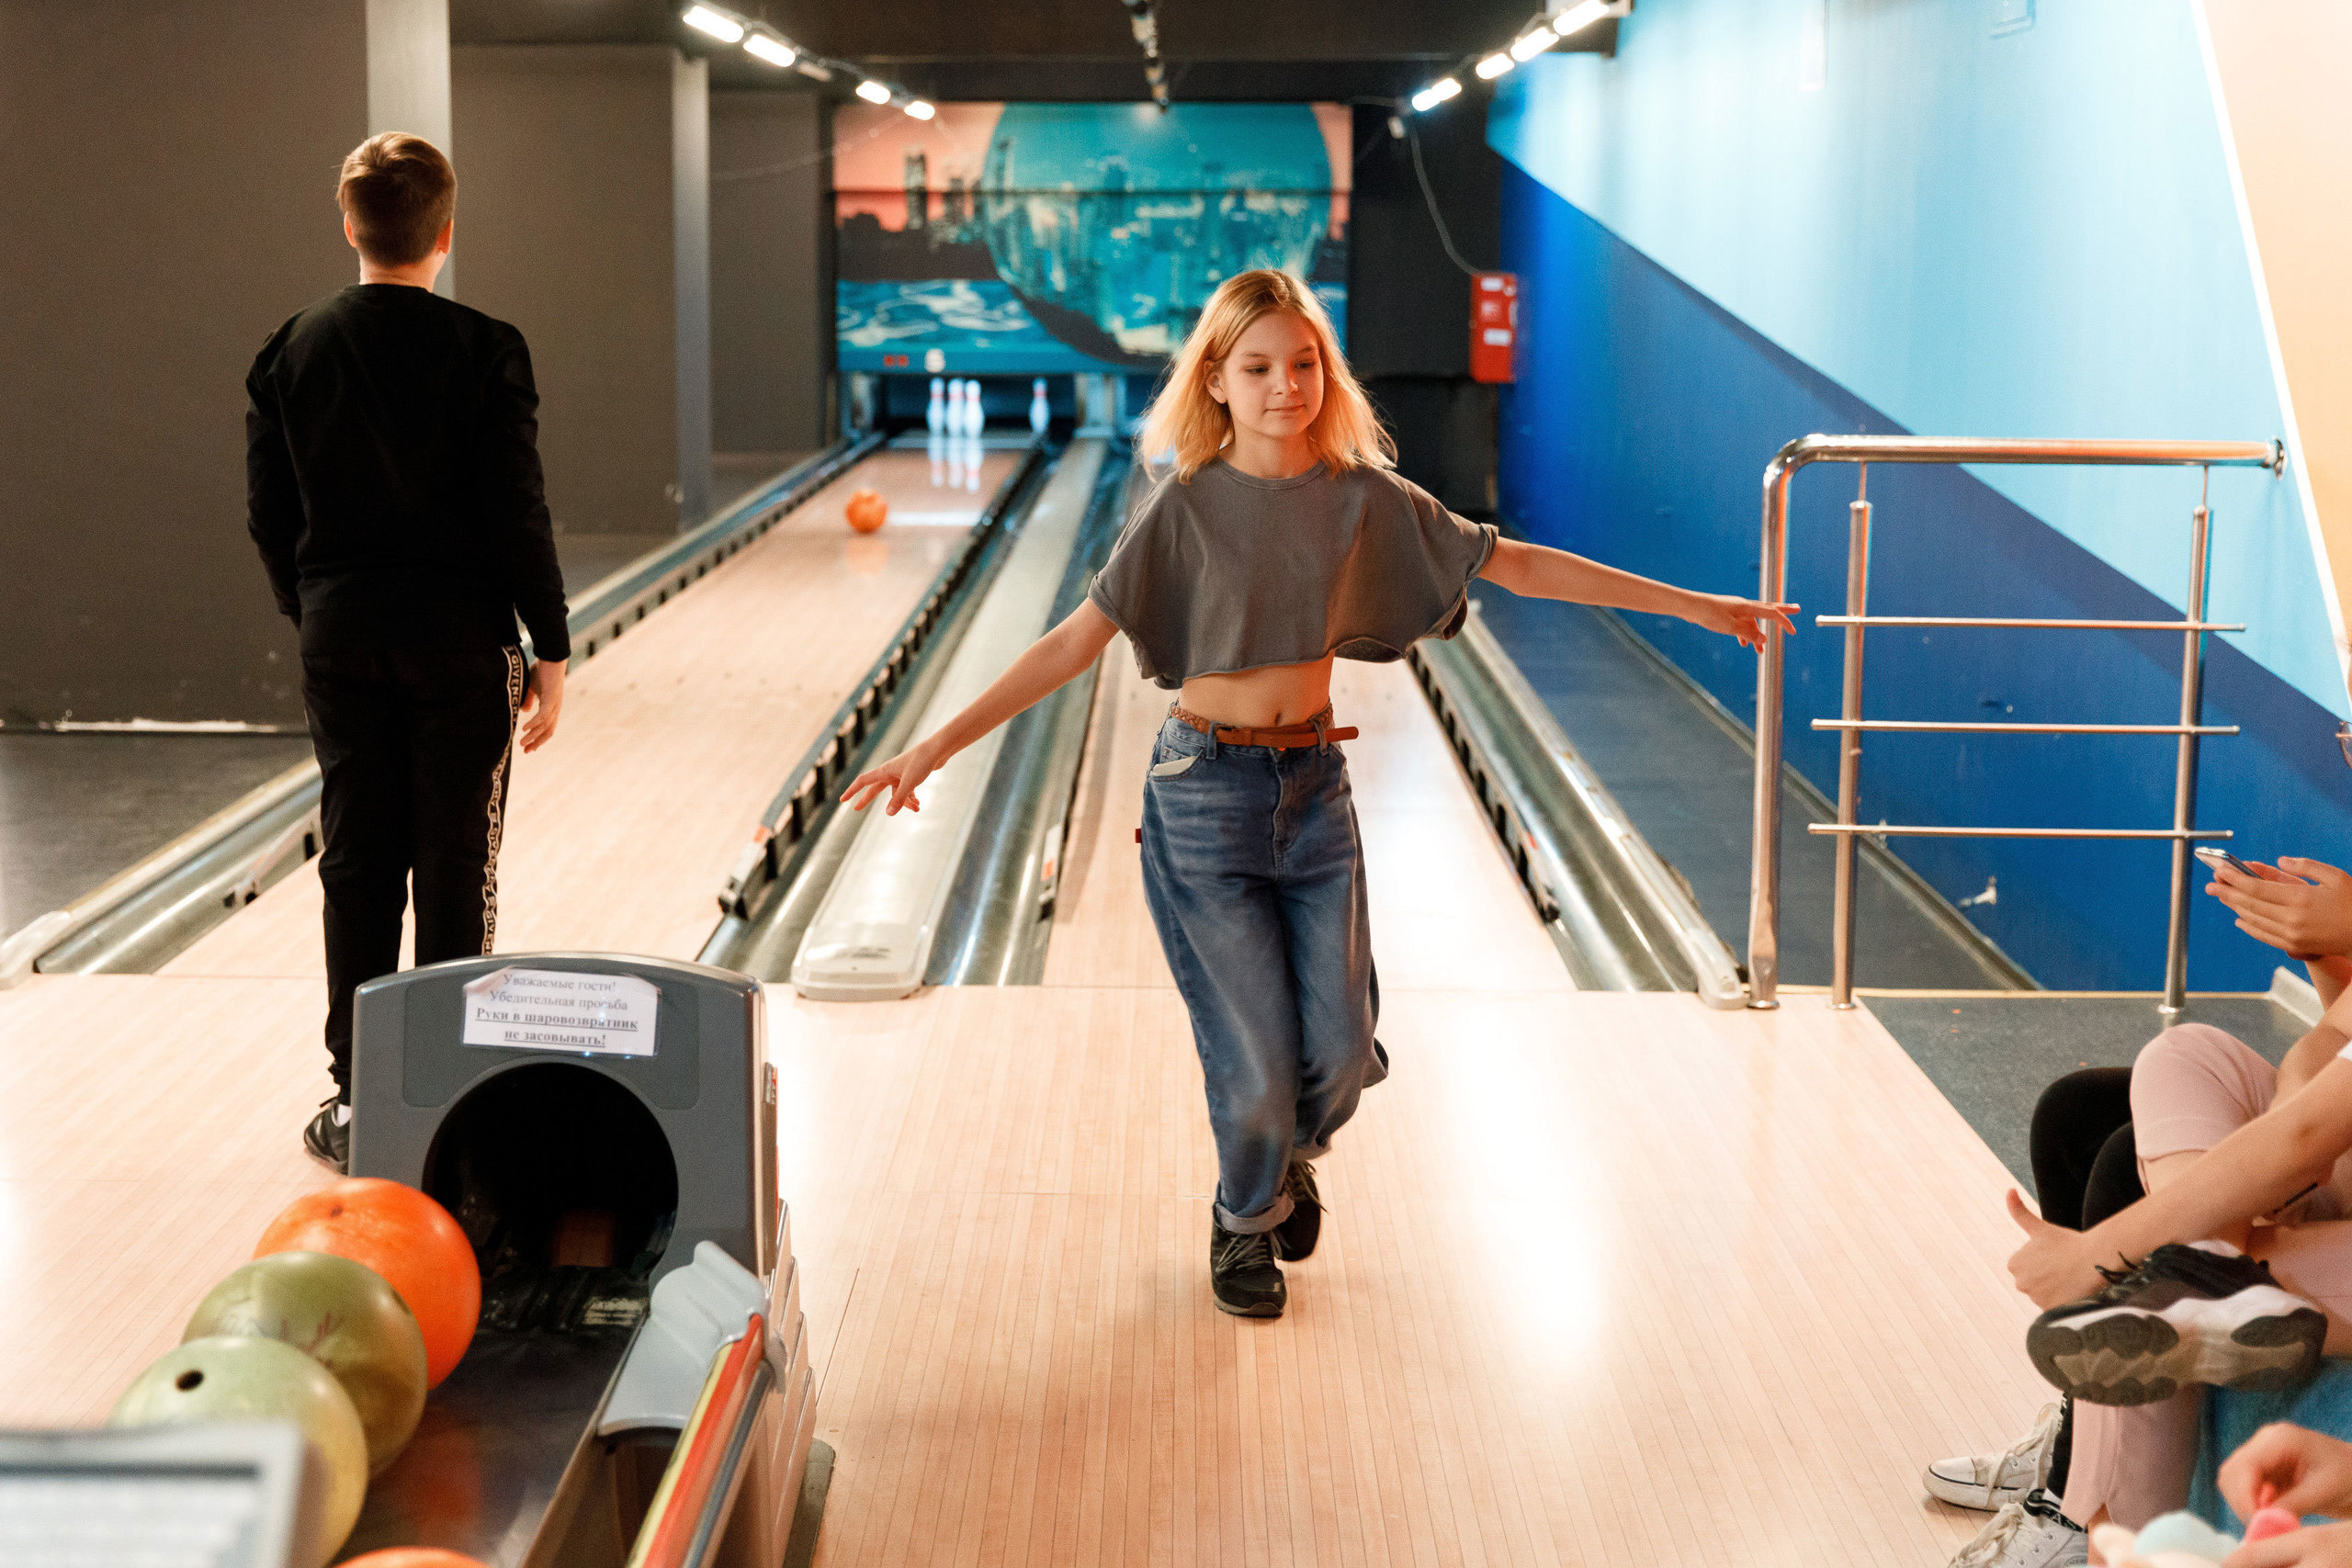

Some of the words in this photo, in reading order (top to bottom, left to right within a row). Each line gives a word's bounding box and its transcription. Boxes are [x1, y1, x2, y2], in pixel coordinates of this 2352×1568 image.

[503, 974, 574, 989] Уважаемые
[578, 981, 616, 992] гости!
[490, 990, 575, 1007] Убедительная
[579, 998, 628, 1011] просьба
[477, 1007, 508, 1021] Руки
[525, 1012, 639, 1029] шаровозвратник
[505, 1030, 520, 1040] не
[524, 1032, 606, 1045] засовывать!
